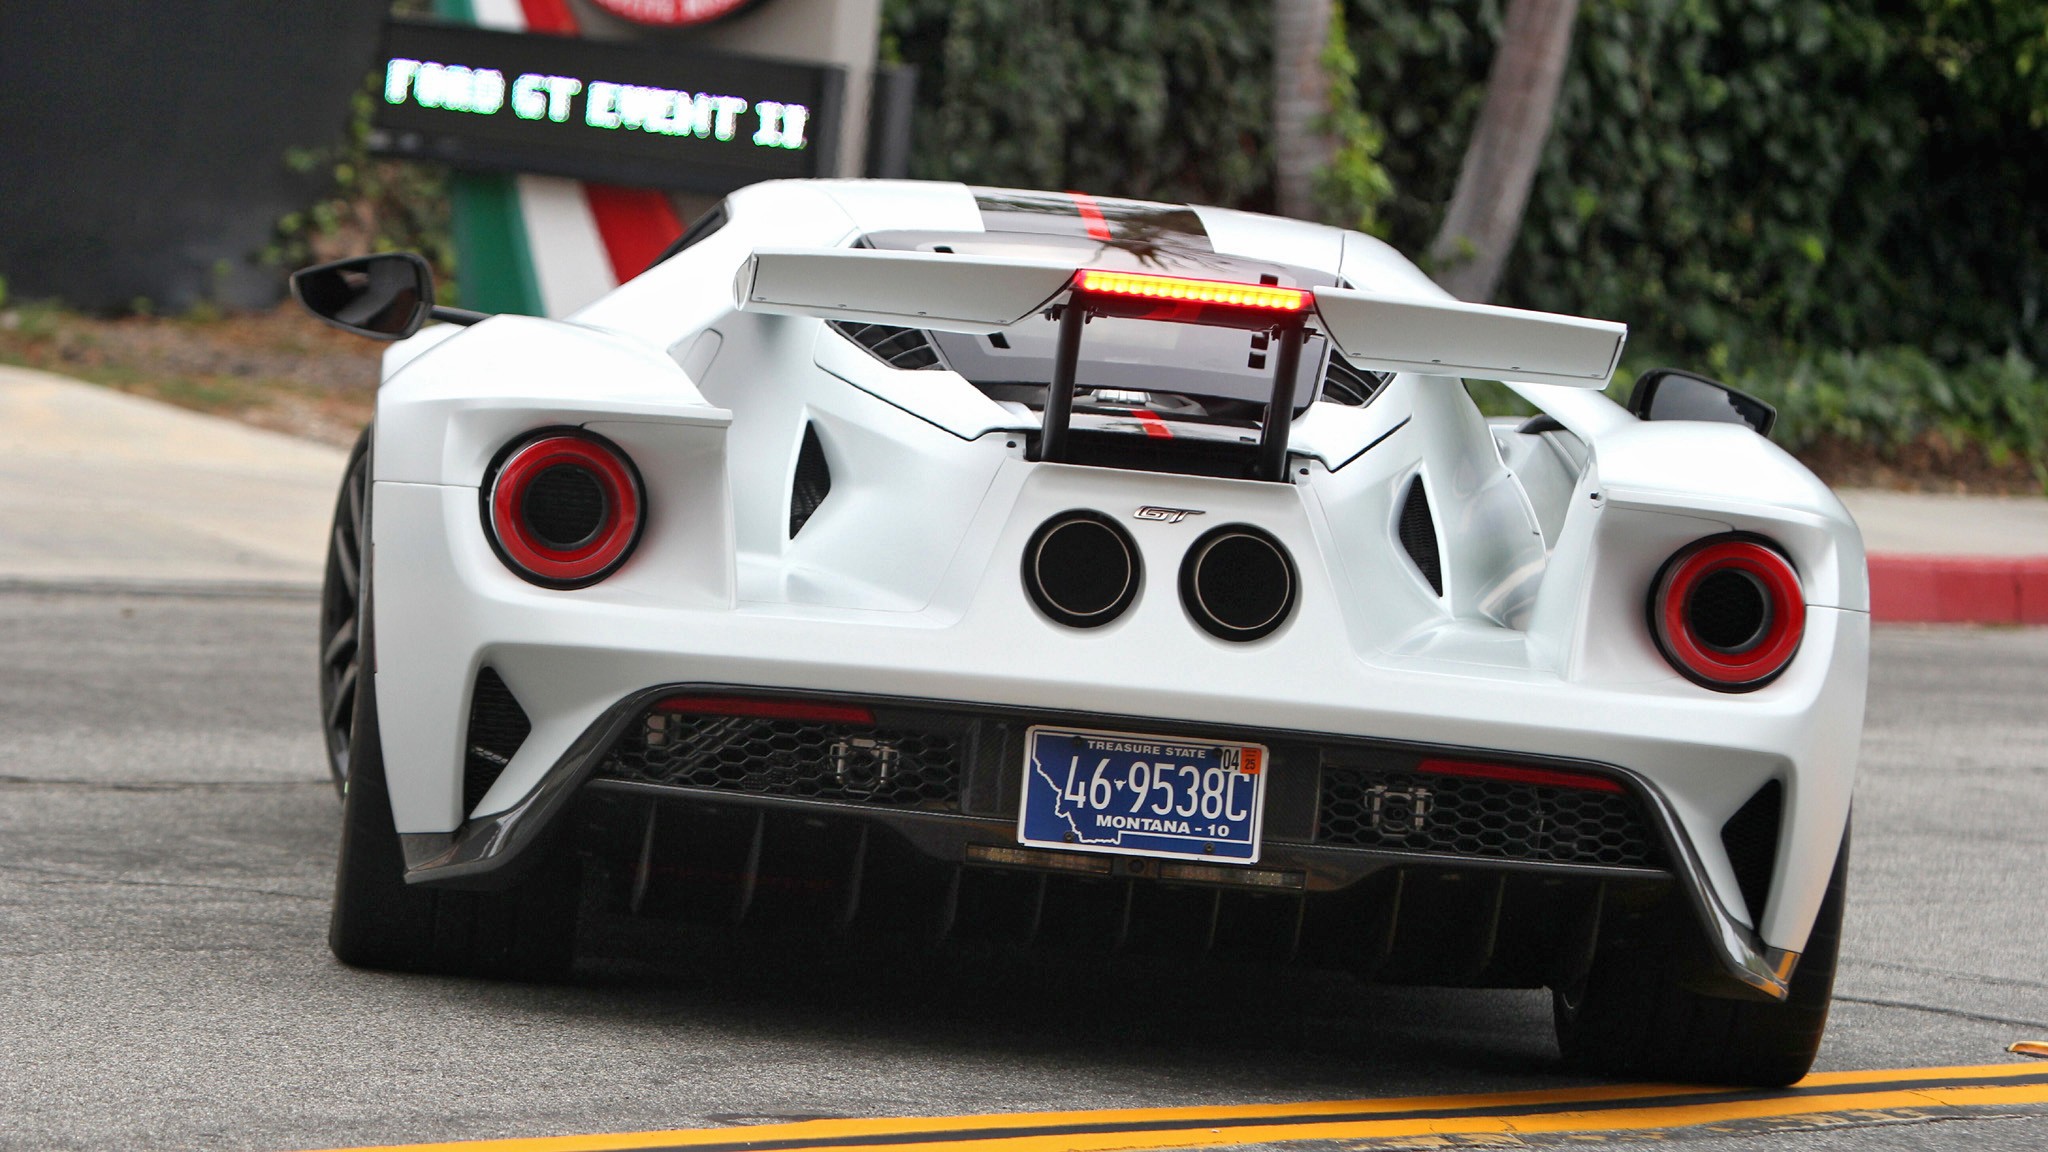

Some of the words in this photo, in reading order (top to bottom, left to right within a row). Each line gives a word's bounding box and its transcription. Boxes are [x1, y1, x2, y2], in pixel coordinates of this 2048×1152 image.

[512, 73, 582, 123] GT
[585, 81, 748, 141] EVENT
[1133, 505, 1206, 524] GT
[1087, 740, 1161, 756] TREASURE
[1165, 746, 1206, 759] STATE
[1222, 748, 1239, 770] 04
[1064, 755, 1112, 810] 46
[1128, 761, 1250, 822] 9538C
[1096, 814, 1190, 834] MONTANA
[1207, 824, 1230, 837] 10
